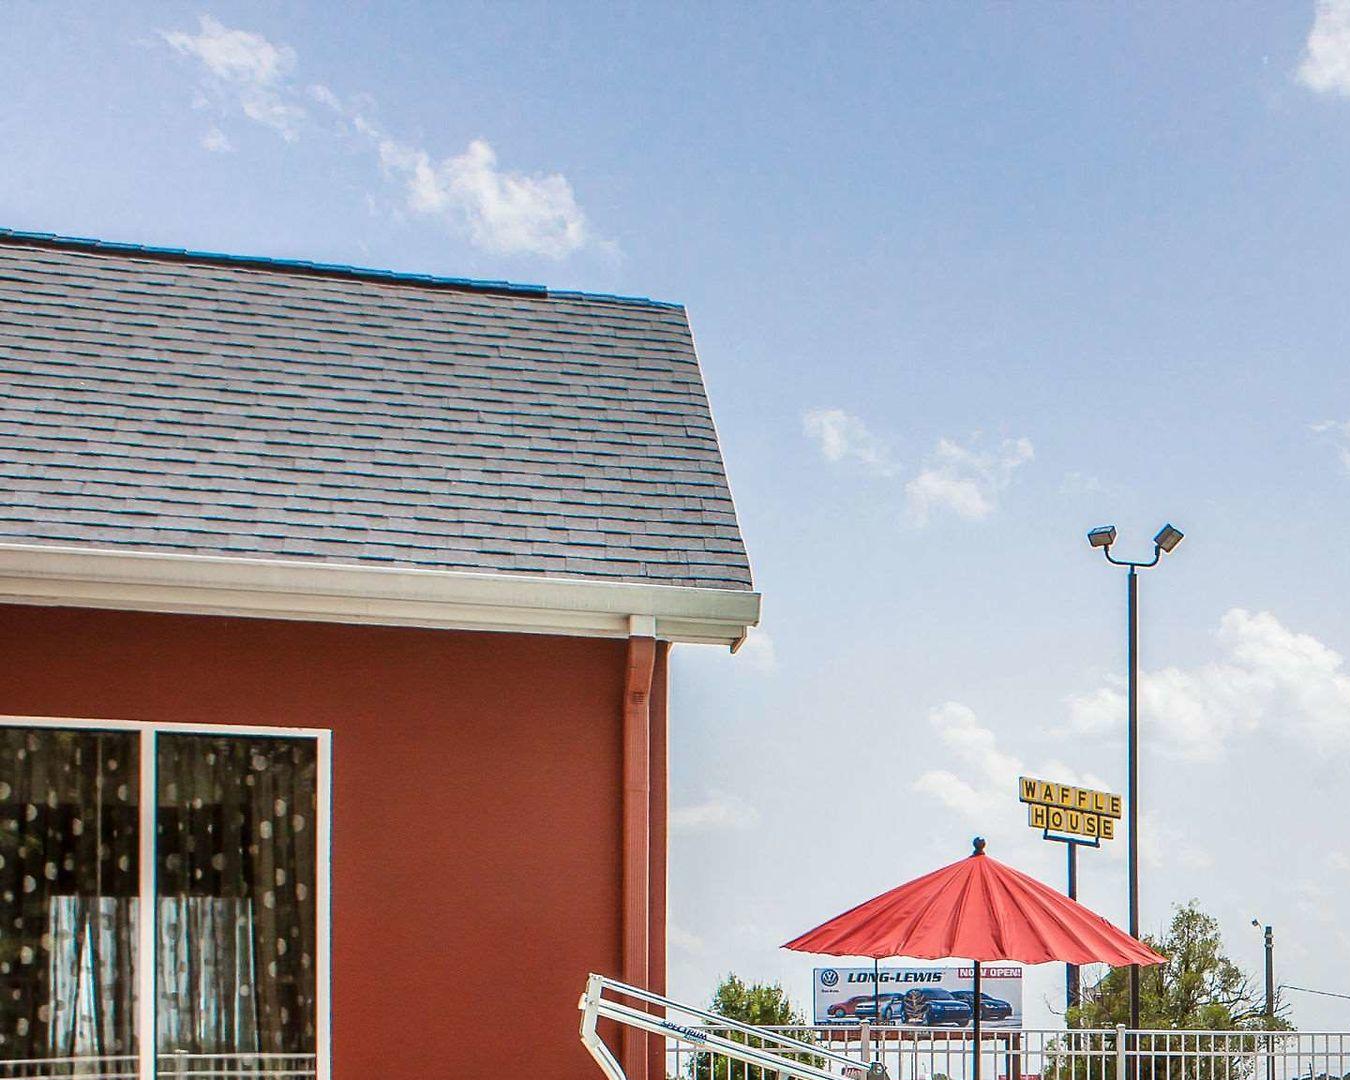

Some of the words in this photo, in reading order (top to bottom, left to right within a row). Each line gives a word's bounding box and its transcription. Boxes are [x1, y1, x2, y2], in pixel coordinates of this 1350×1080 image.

[1024, 780, 1120, 813] WAFFLE
[1034, 807, 1112, 836] HOUSE
[847, 972, 942, 983] LONG-LEWIS
[990, 968, 1021, 977] OPEN!
